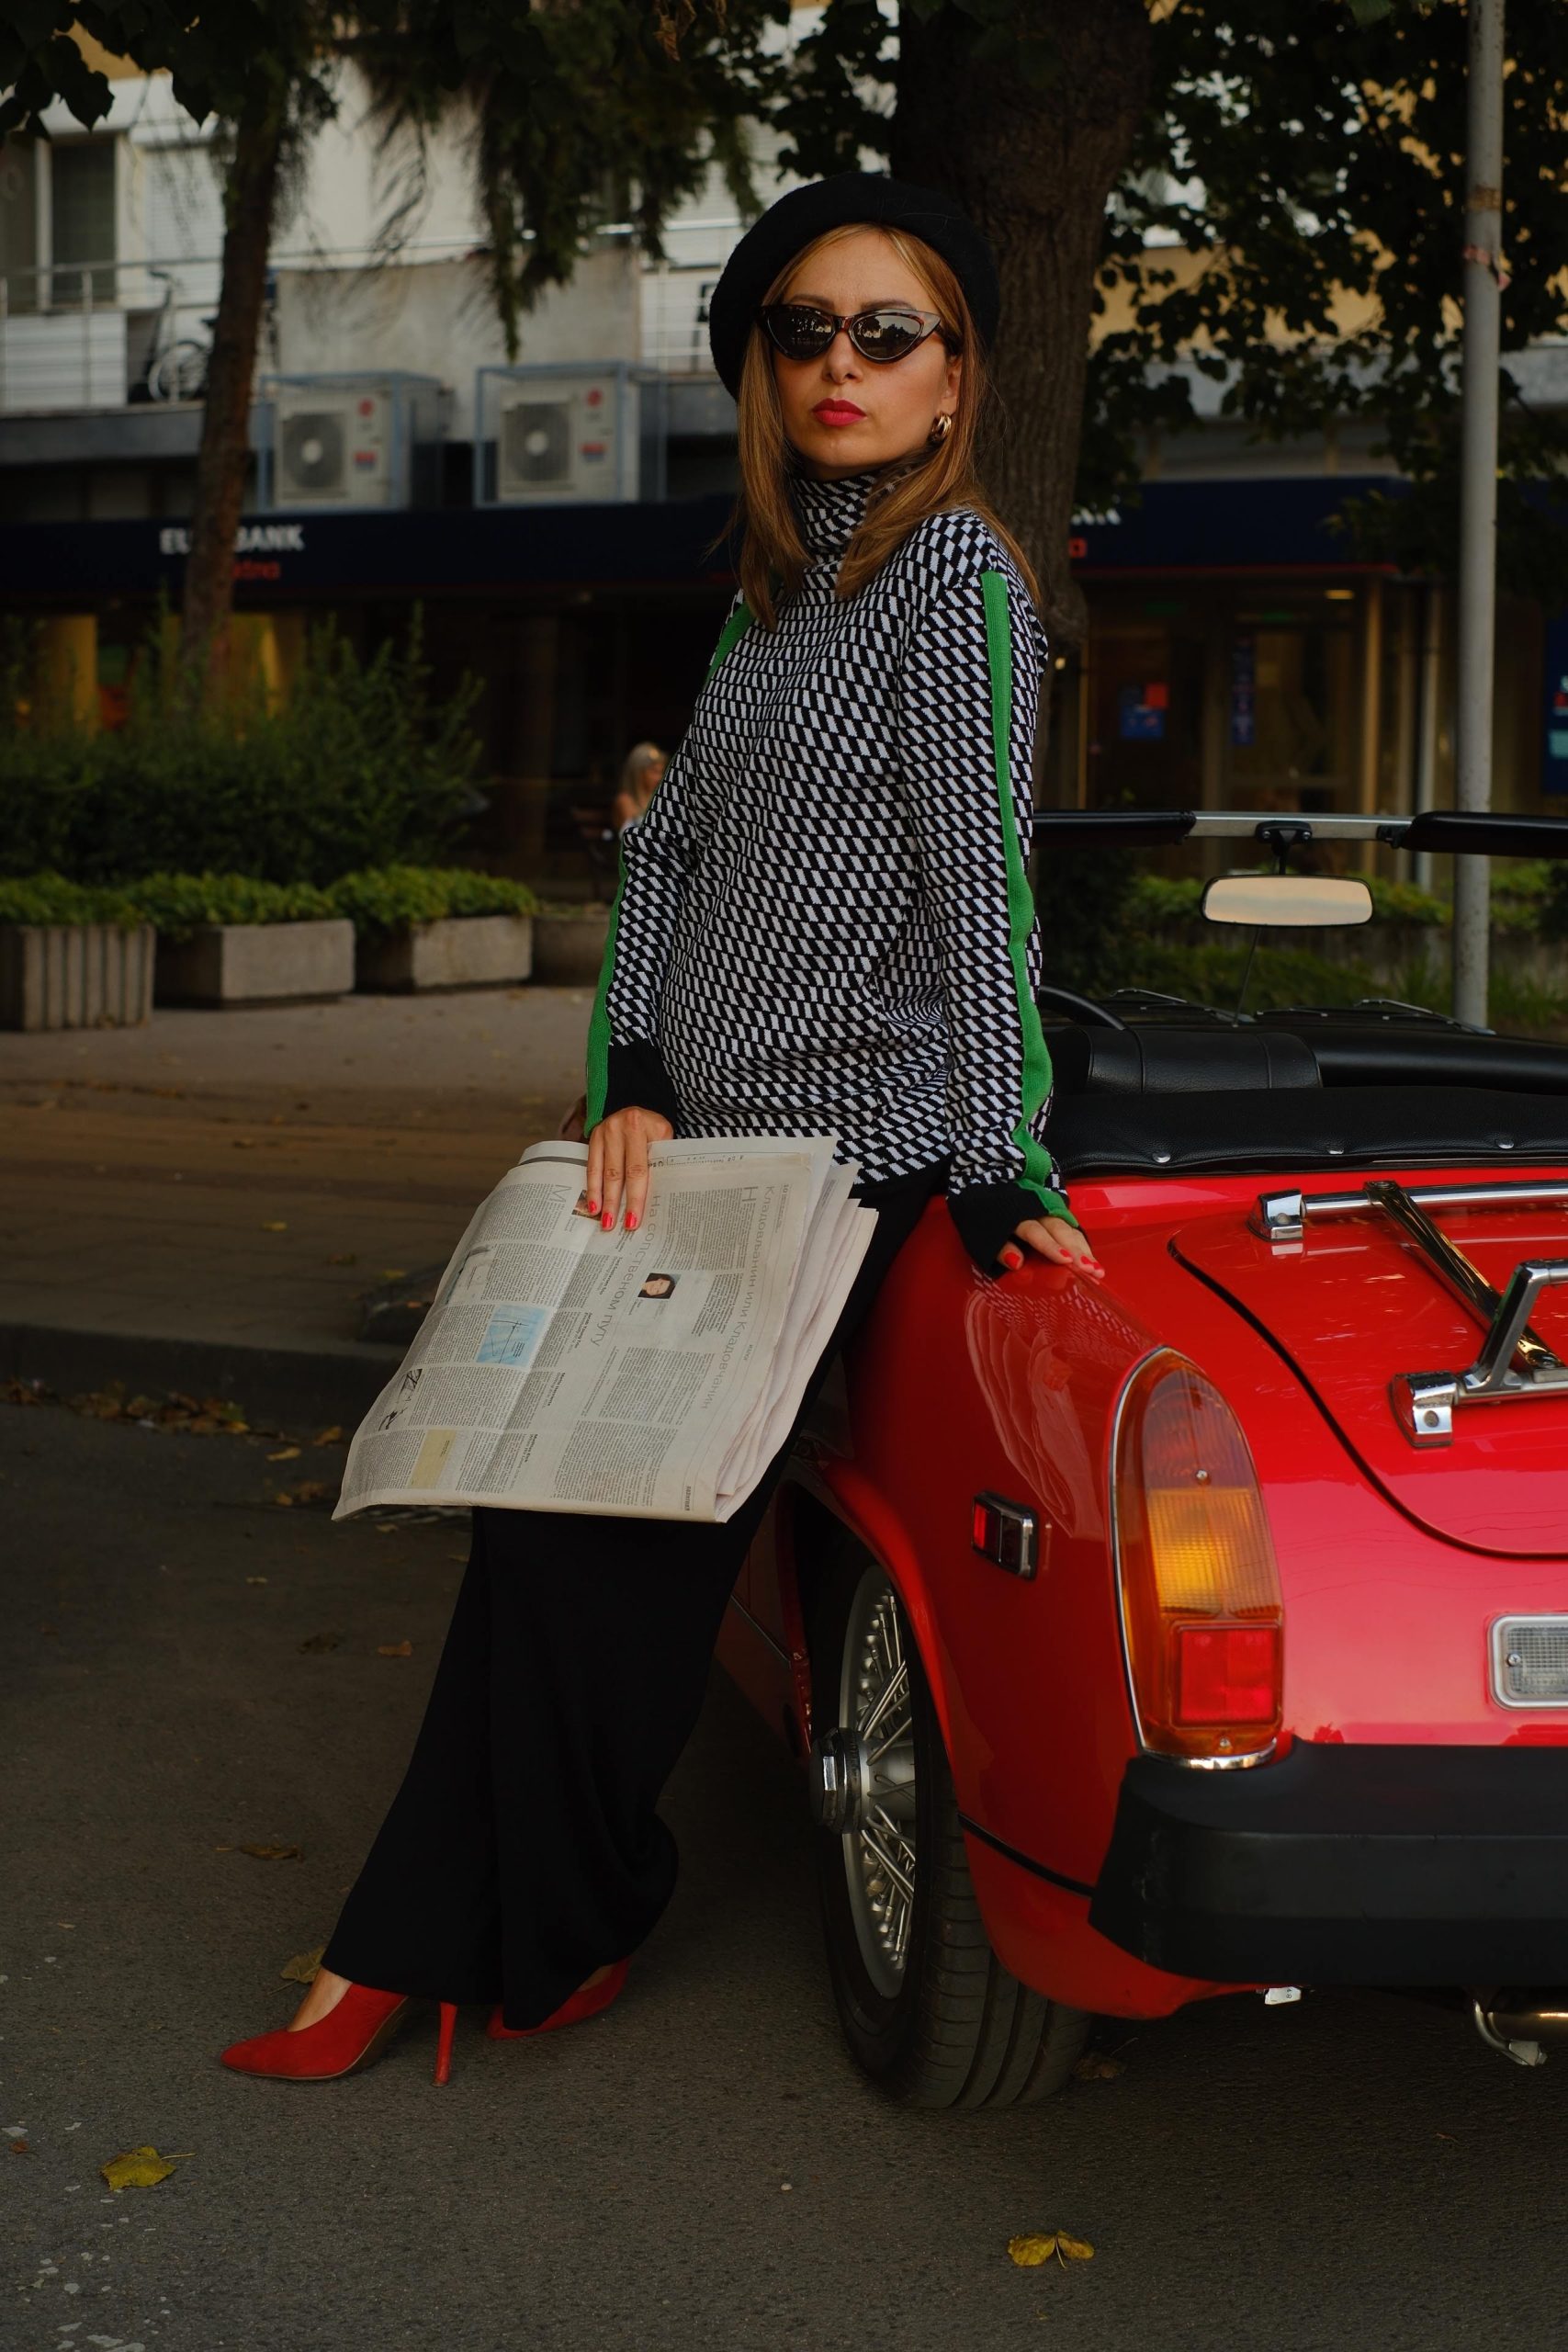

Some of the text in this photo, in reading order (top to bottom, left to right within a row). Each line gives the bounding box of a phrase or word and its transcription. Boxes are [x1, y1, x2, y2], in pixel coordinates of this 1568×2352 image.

[160, 525, 305, 554] EUBANK
[649, 1194, 660, 1217] На
[747, 1185, 774, 1287] Кладовљанин
[606, 1222, 658, 1310] сопственом
[739, 1291, 754, 1317] или
[588, 1314, 615, 1347] путу
[701, 1320, 746, 1409] Кладовчанин
